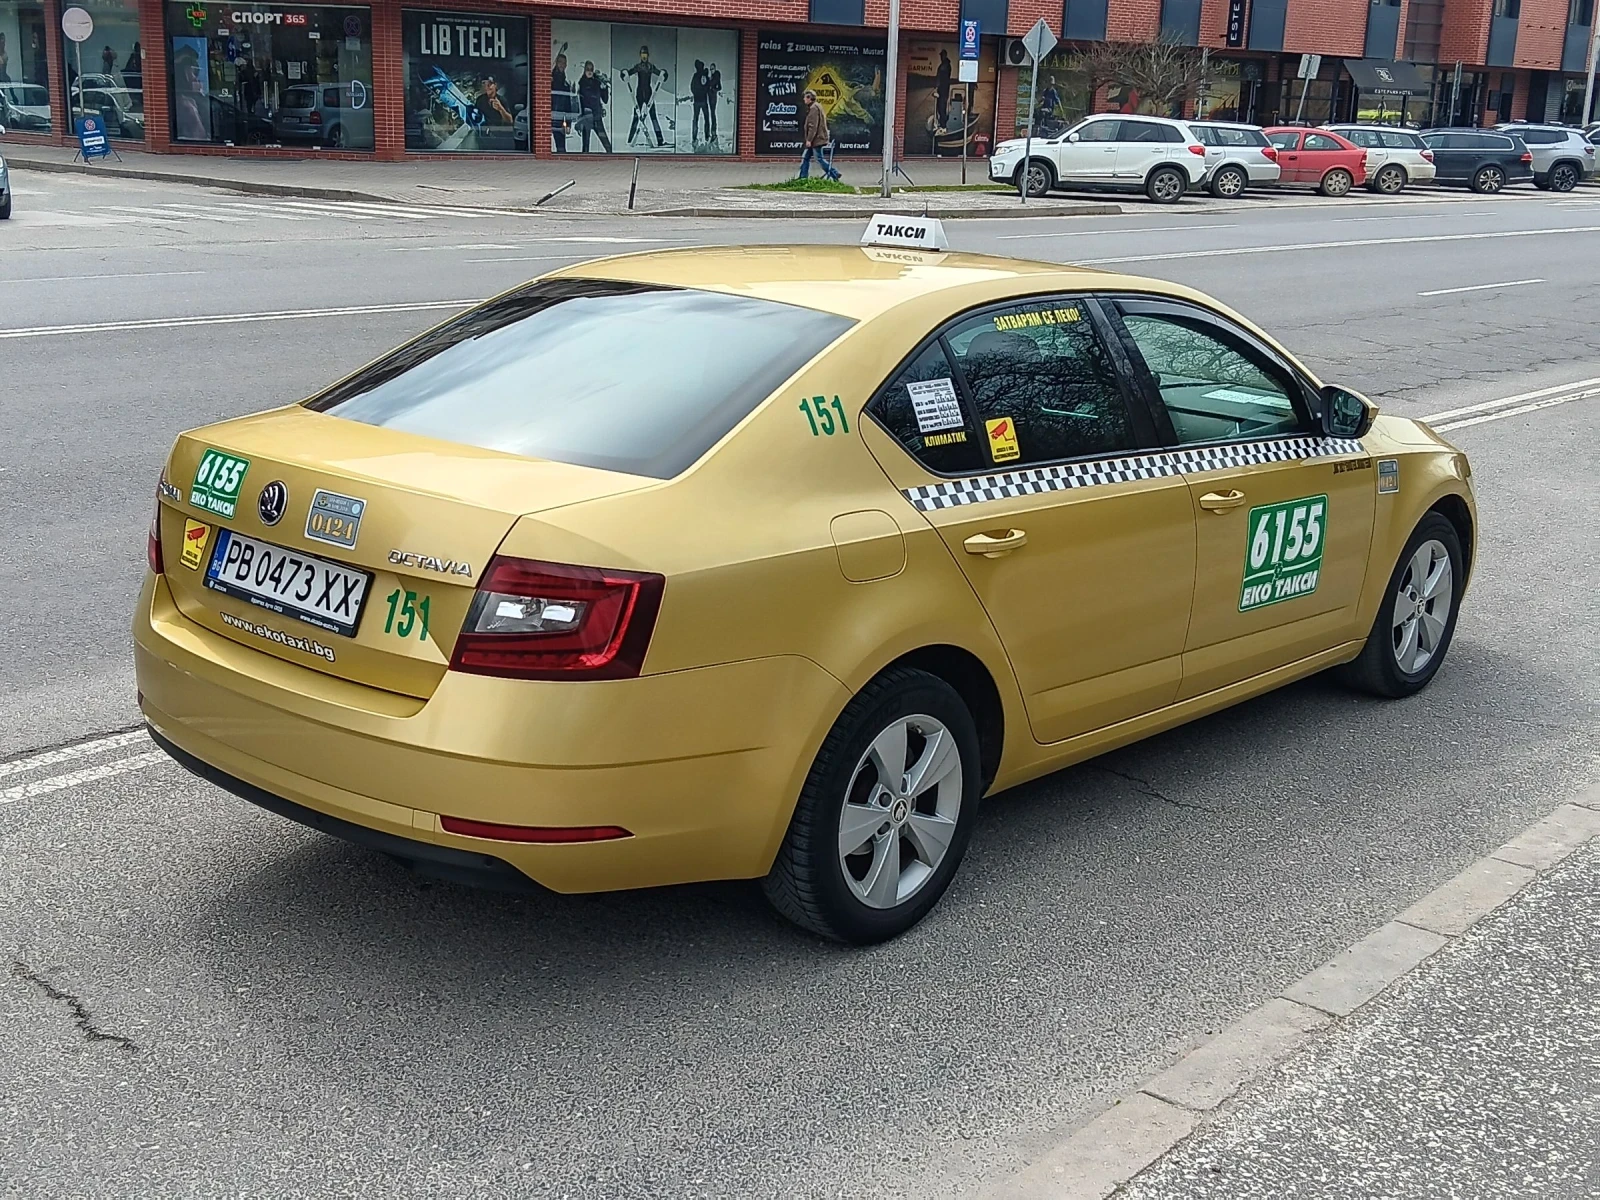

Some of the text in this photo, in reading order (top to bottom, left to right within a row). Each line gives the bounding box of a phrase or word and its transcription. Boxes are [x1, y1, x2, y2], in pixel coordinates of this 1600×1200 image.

[231, 11, 305, 25] СПОРТ 365
[1230, 3, 1240, 41] ESTE
[421, 23, 506, 58] LIB TECH
[862, 47, 884, 56] Mustad
[908, 64, 933, 72] GARMIN
[766, 102, 798, 116] Jackson
[877, 223, 926, 240] ТАКСИ
[993, 307, 1082, 332] ЗАТВАРЯМ СЕ ЛЕКО!
[798, 395, 849, 436] 151
[924, 431, 967, 447] КЛИМАТИК
[197, 453, 246, 493] 6155
[190, 491, 235, 516] ЕКО ТАКСИ
[312, 513, 354, 540] 0424
[1250, 502, 1324, 570] 6155
[211, 559, 221, 571] BG
[388, 549, 472, 578] OCTAVIA
[222, 540, 361, 617] PB 0473 XX
[1240, 569, 1319, 608] ЕКО ТАКСИ
[384, 588, 430, 641] 151
[220, 612, 335, 662] www.ekotaxi.bg
